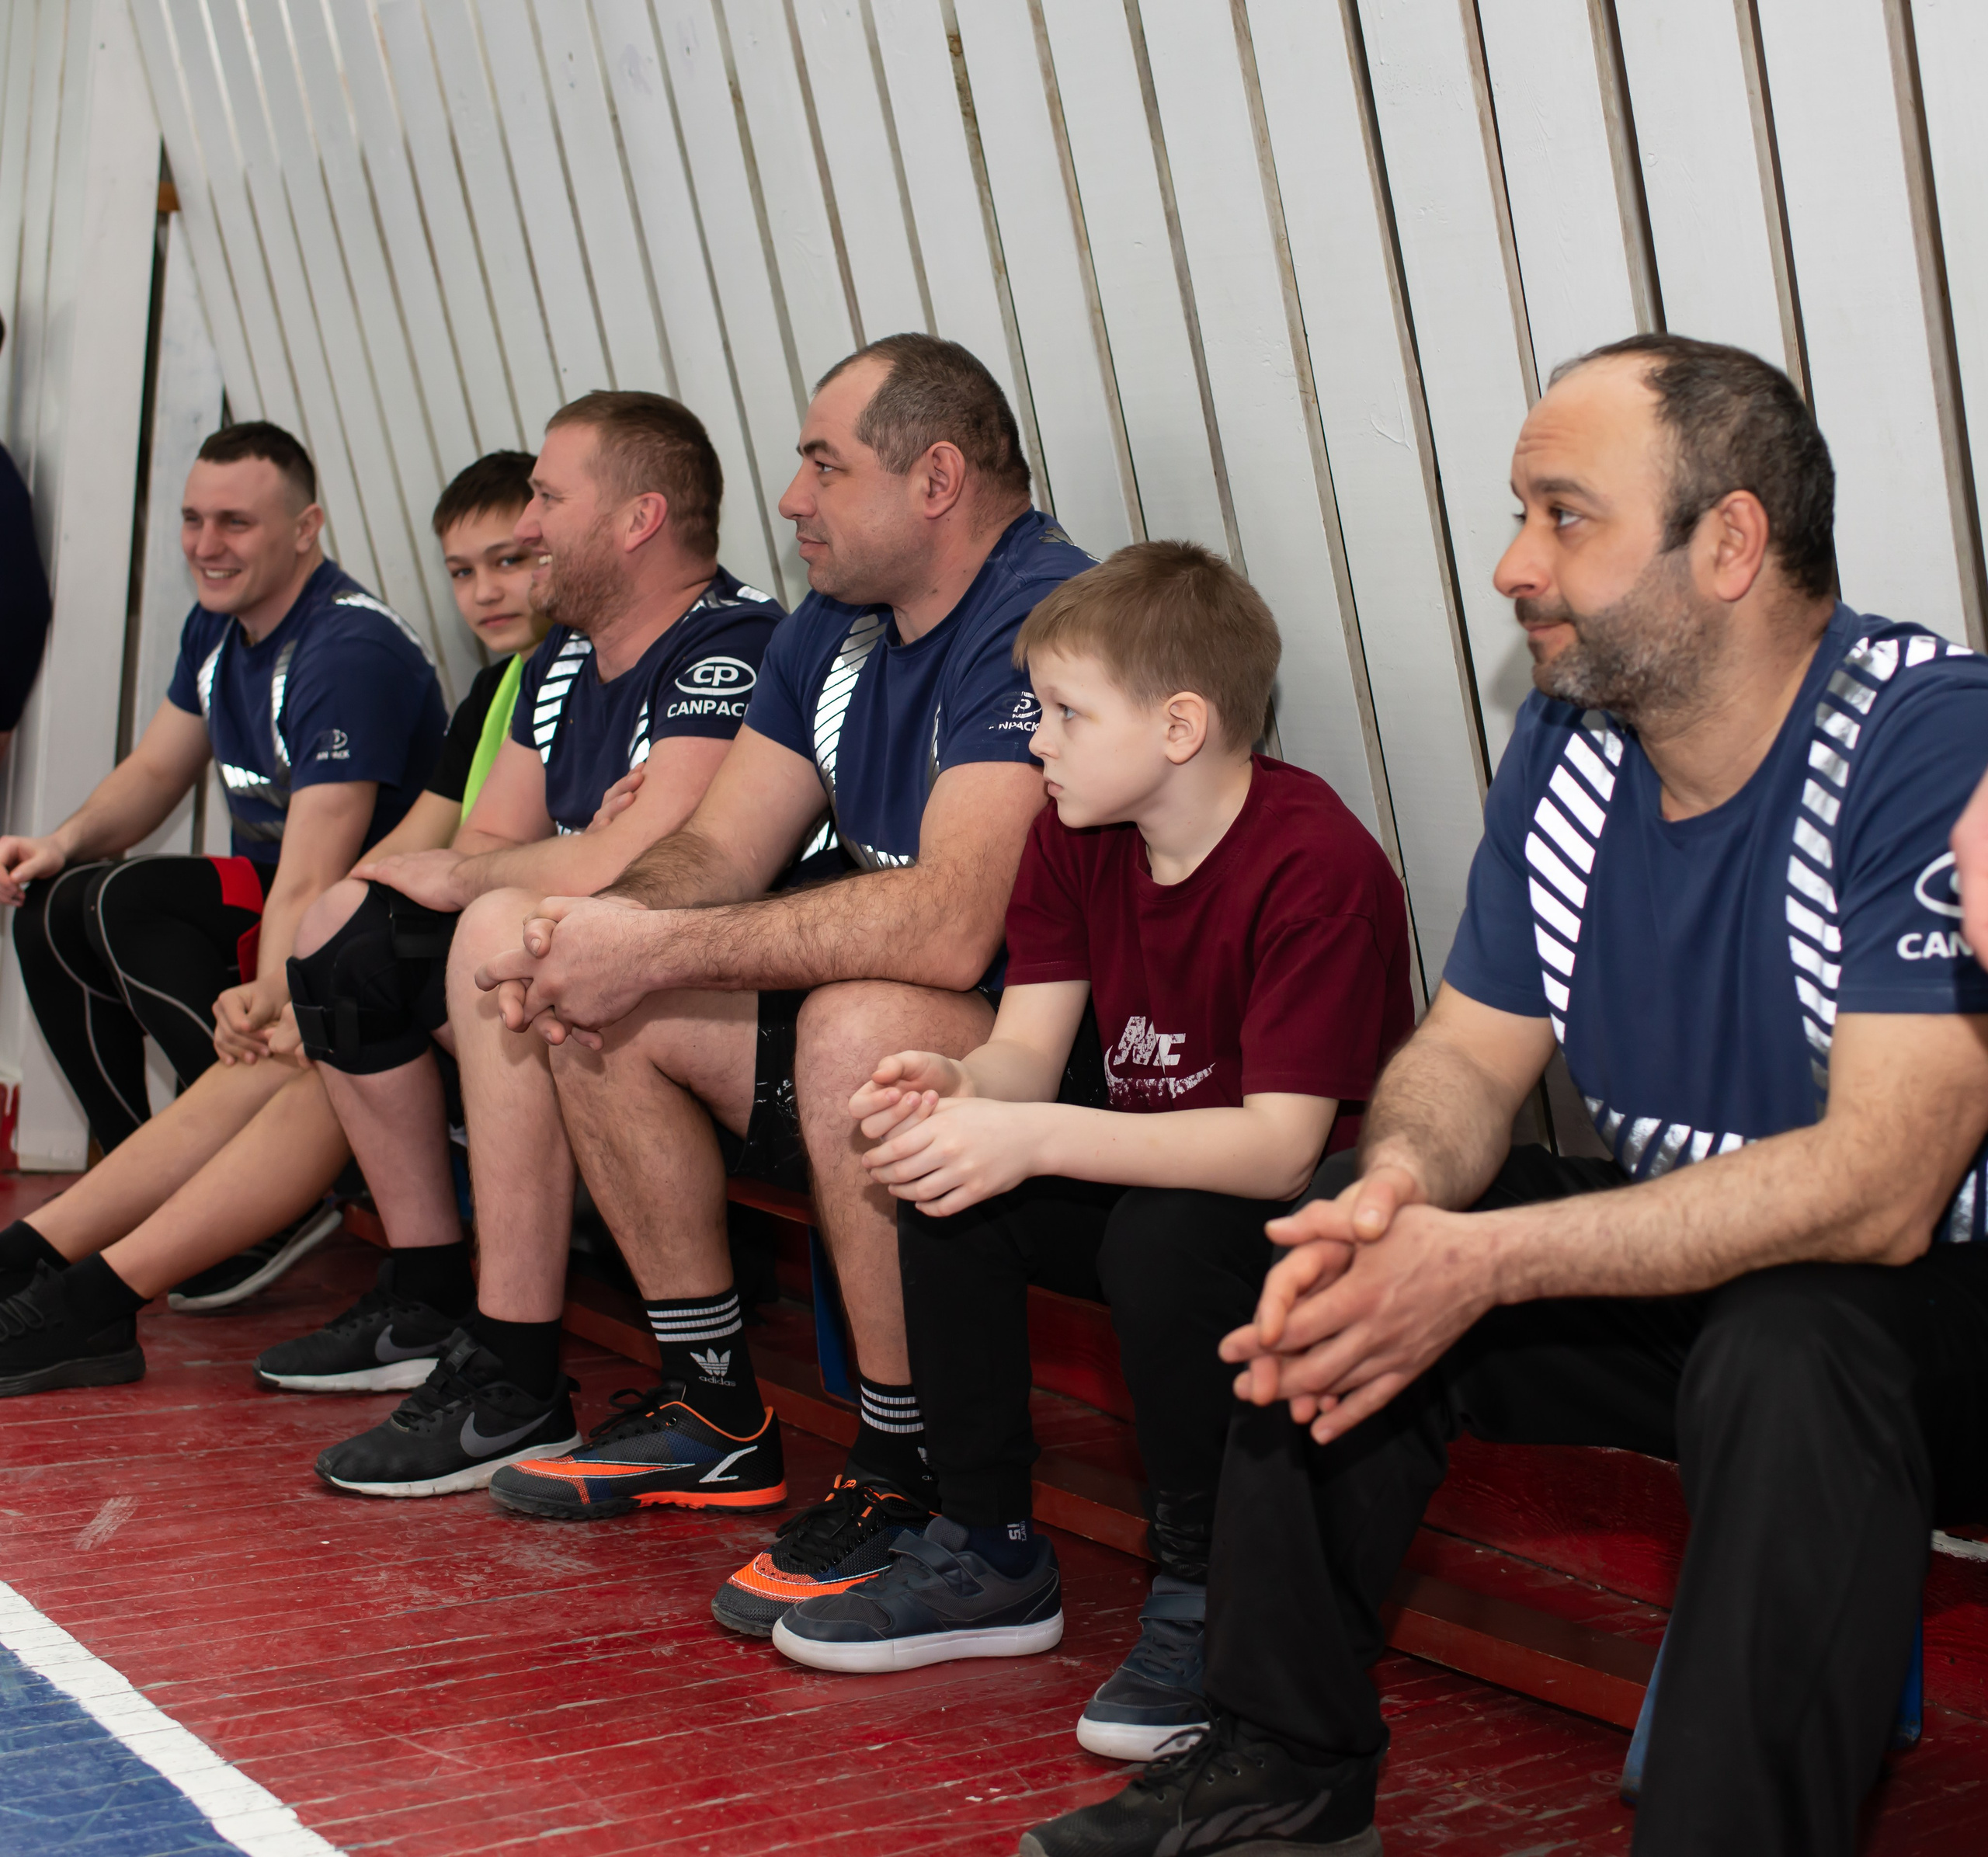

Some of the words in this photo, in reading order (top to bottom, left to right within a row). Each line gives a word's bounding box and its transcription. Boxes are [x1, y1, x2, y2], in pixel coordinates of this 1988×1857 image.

[693, 666, 739, 687] CP
[667, 700, 749, 718] CANPAC
[982, 721, 1040, 732] NPACK
[698, 1375, 736, 1387] adidas
